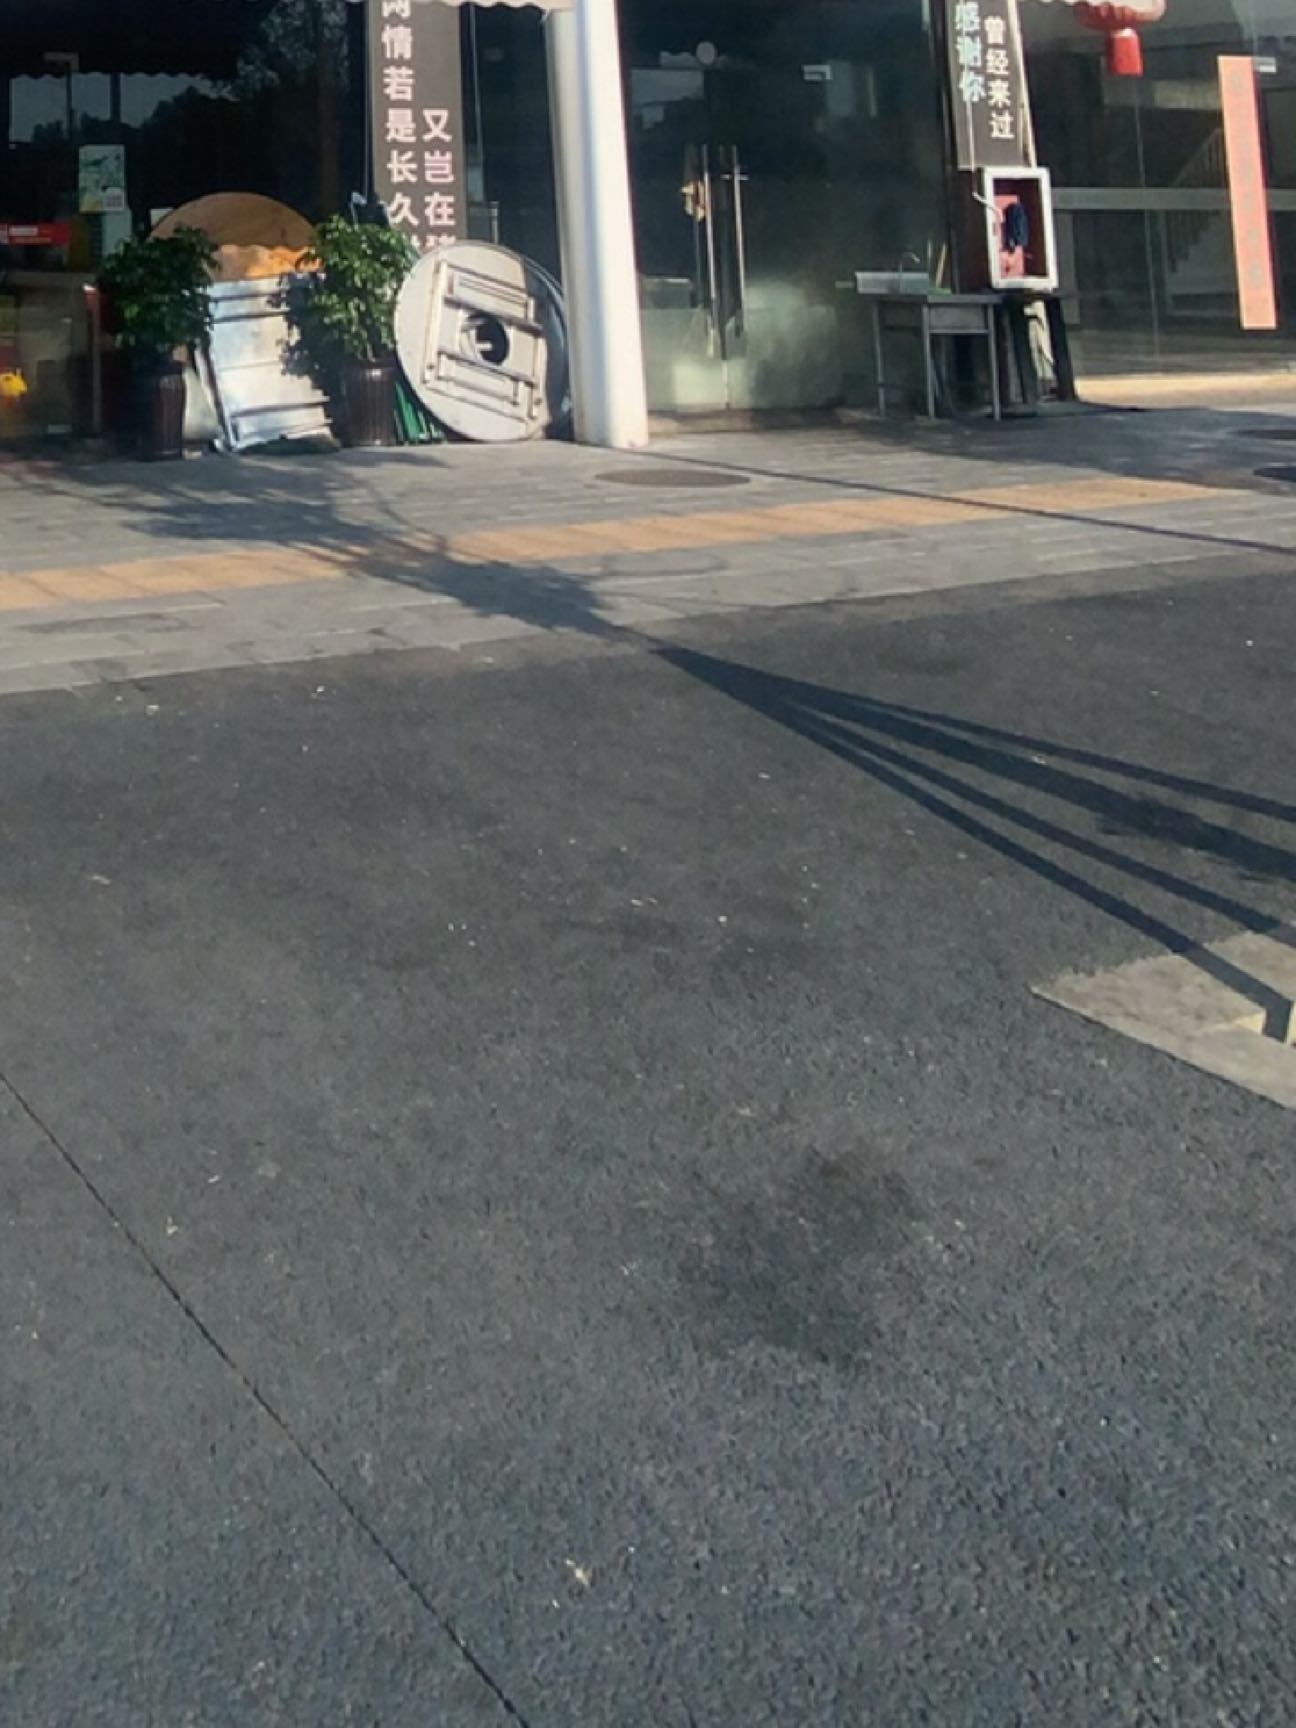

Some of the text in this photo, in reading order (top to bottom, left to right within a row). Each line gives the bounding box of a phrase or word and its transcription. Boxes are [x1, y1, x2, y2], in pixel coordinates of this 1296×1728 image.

[955, 1, 987, 103] 感谢你
[984, 15, 1016, 139] 曾经来过
